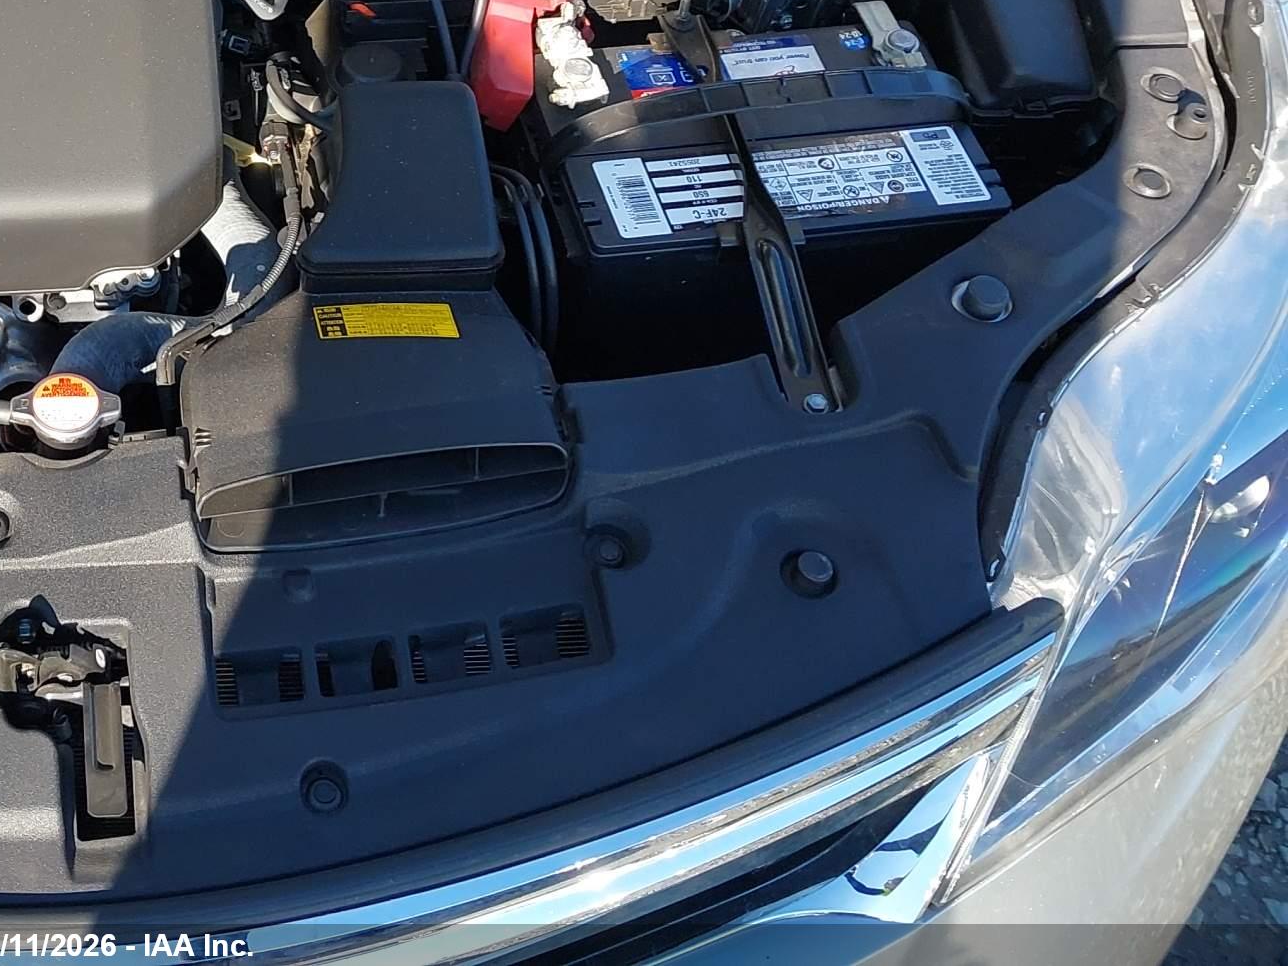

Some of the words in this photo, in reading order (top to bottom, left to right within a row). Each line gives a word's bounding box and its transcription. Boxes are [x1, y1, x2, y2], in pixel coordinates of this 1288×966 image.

[769, 54, 784, 62] you
[786, 52, 810, 60] Power
[686, 175, 703, 183] 110
[692, 207, 728, 219] 24F-C
